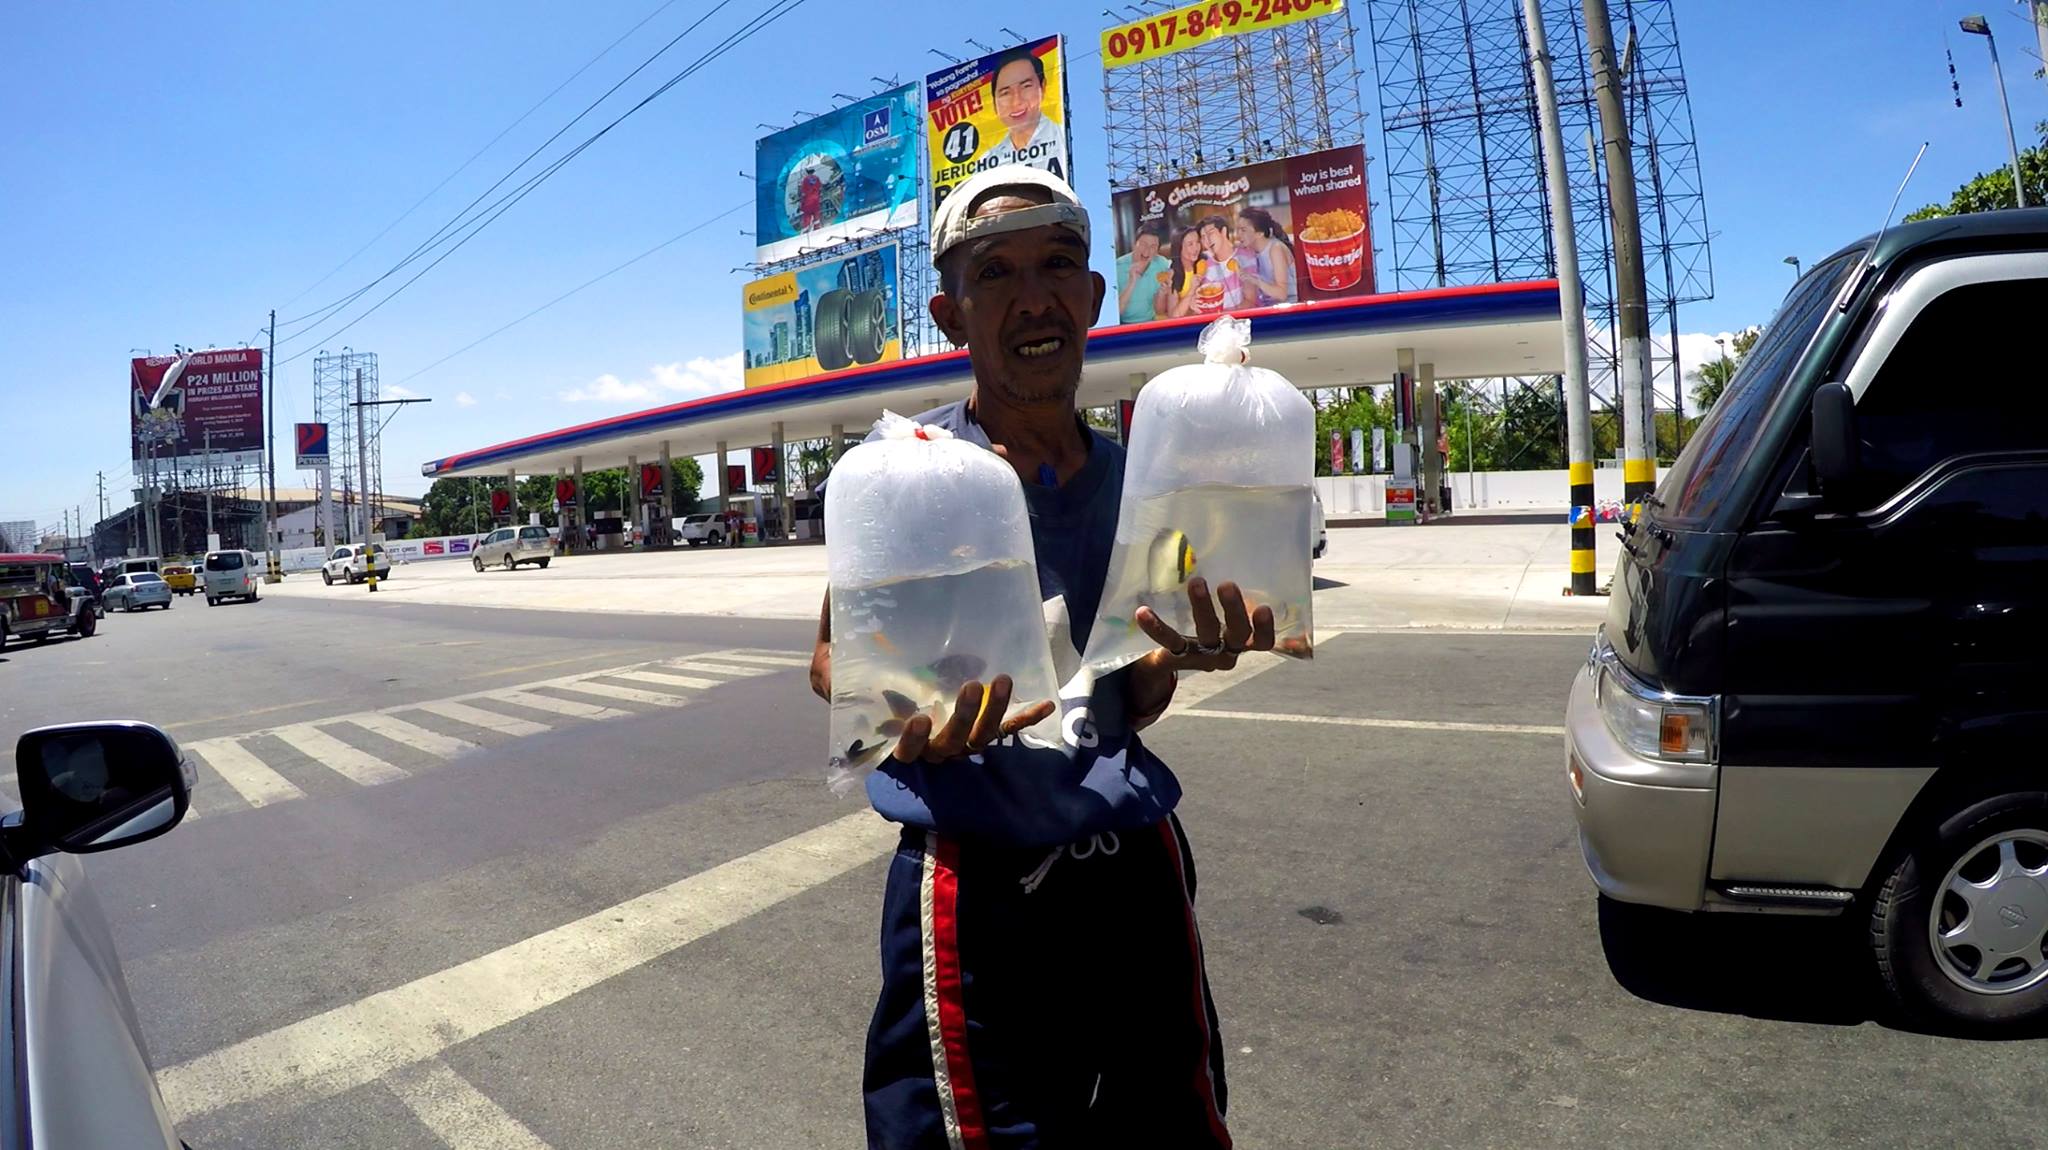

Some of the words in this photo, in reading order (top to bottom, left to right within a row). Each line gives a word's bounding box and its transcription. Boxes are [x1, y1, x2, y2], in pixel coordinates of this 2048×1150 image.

[1108, 0, 1332, 58] 0917-849-24
[931, 89, 983, 132] VOTE!
[866, 124, 888, 140] OSM
[945, 125, 975, 160] 41
[935, 155, 1000, 184] JERICHO
[1300, 172, 1318, 183] Joy
[1320, 169, 1328, 180] is
[1329, 164, 1353, 178] best
[1168, 176, 1250, 206] Chickenjoy
[1294, 184, 1324, 196] when
[1325, 174, 1361, 192] shared
[188, 355, 213, 366] ORLD
[214, 352, 247, 364] MANILA
[212, 370, 258, 385] MILLION
